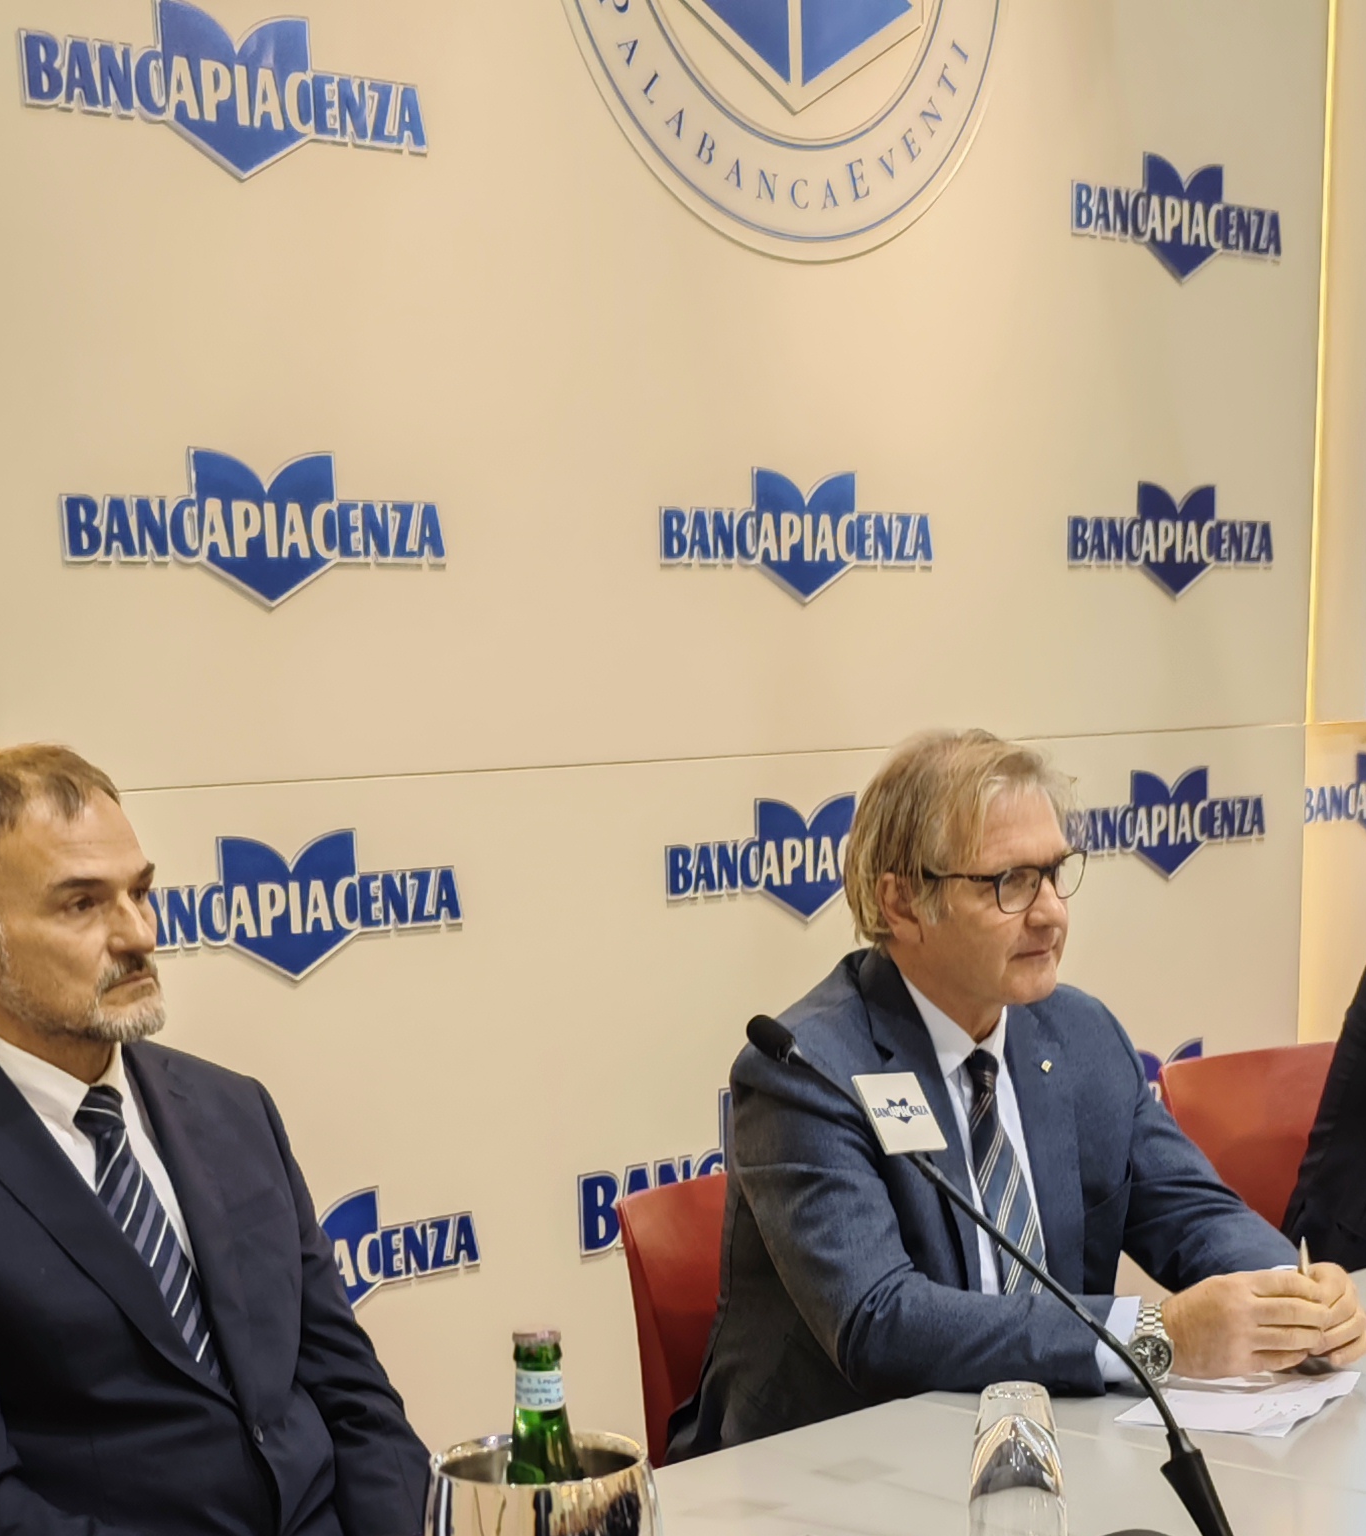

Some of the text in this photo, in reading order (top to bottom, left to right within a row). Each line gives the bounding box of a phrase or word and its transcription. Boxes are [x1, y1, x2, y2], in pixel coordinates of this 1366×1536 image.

[22, 29, 428, 149] BANCAPIACENZA
[1073, 182, 1281, 257] BANCAPIACENZA
[63, 494, 439, 559] BANCAPIACENZA
[662, 507, 933, 563] BANCAPIACENZA
[1068, 517, 1273, 564] BANCAPIACENZA
